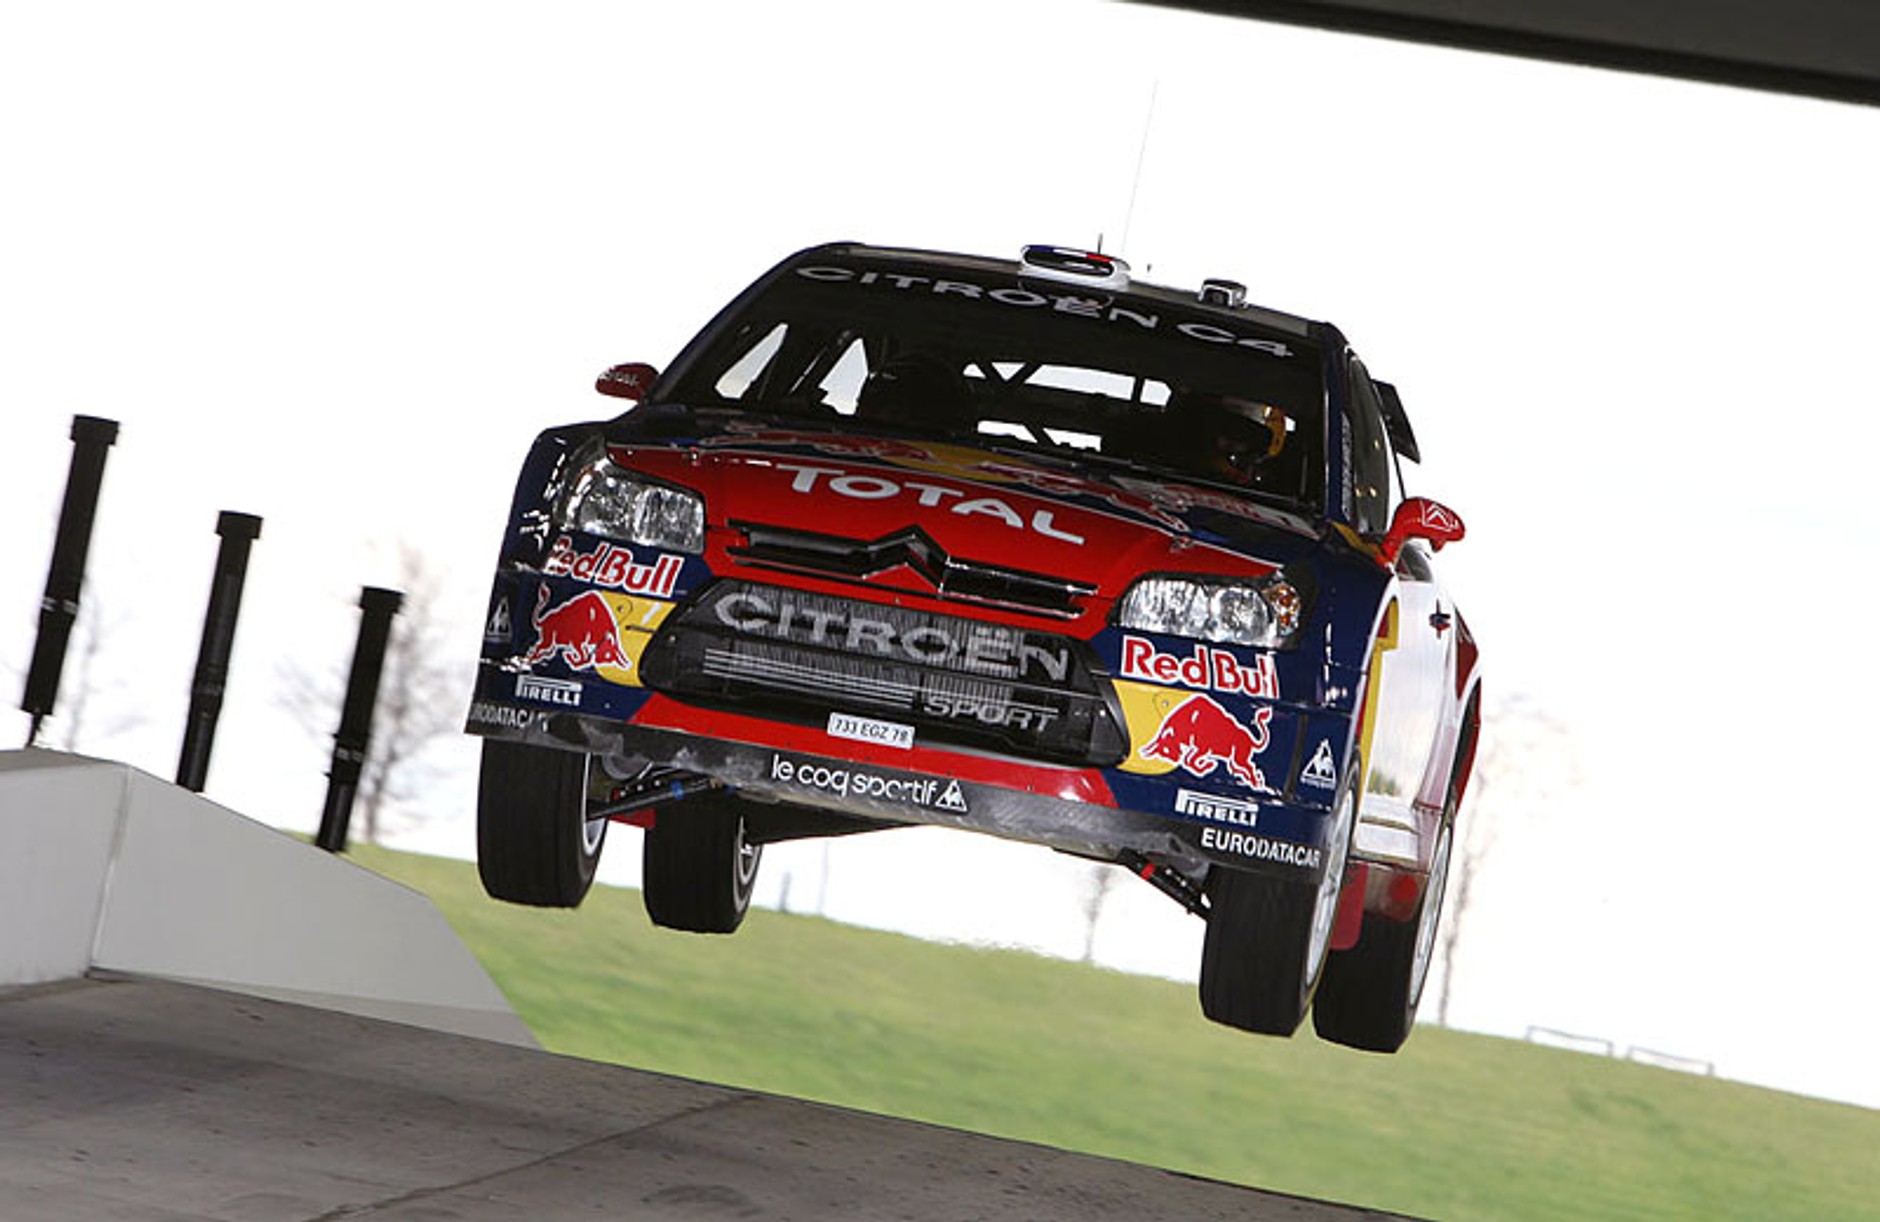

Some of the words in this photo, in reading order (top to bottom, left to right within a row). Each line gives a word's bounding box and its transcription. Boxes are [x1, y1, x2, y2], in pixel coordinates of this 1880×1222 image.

[1177, 323, 1294, 357] C4
[776, 463, 1085, 545] TOTAL
[542, 535, 610, 583] Red
[594, 546, 685, 598] Bull
[715, 592, 1069, 681] CITROËN
[1121, 635, 1211, 690] Red
[1211, 648, 1280, 699] Bull
[515, 675, 582, 706] PIRELLI
[836, 719, 858, 734] 733
[860, 722, 889, 739] EGZ
[924, 695, 1058, 732] SPORT
[772, 754, 794, 781] le
[798, 765, 849, 798] coq
[851, 773, 938, 806] sportif
[1175, 788, 1259, 828] PIRELLI
[1201, 826, 1322, 869] EURODATACAR
